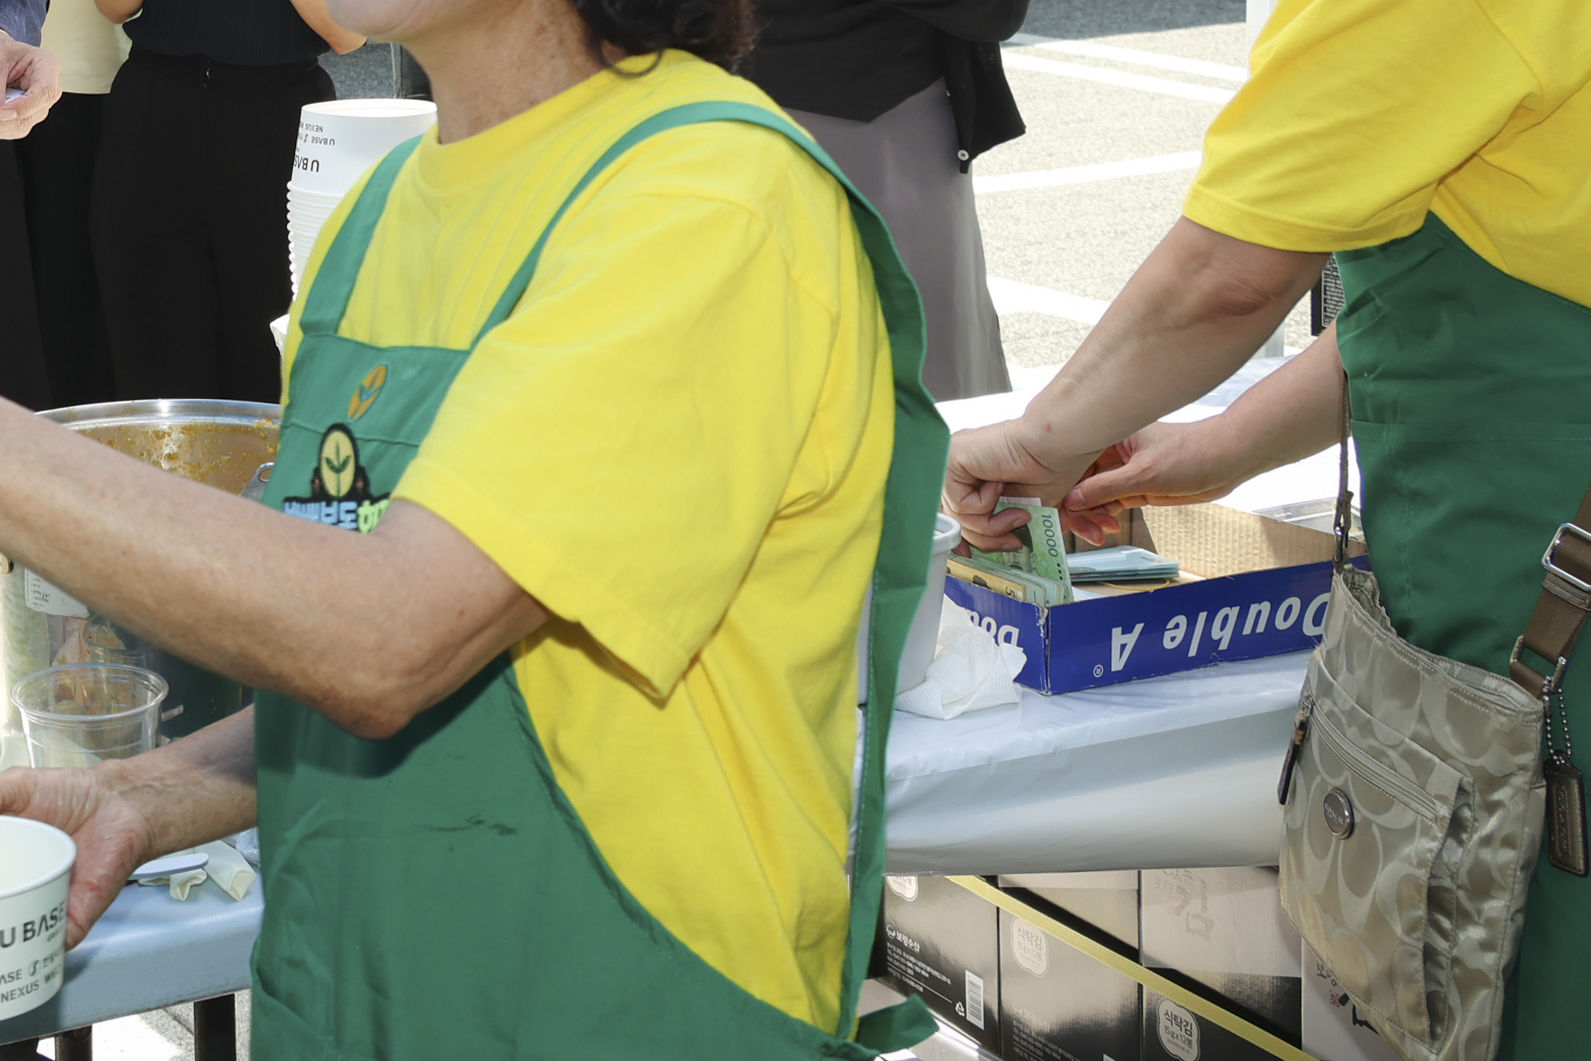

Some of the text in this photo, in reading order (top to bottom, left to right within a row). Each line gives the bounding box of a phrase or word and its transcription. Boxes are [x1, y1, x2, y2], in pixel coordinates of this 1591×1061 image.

[293, 155, 309, 171] BAS
[1041, 513, 1059, 558] 10000
[1110, 592, 1332, 672] Double A
[896, 930, 921, 954] 보령수산
[1017, 925, 1043, 952] 식탁김
[0, 979, 40, 1003] NEXUS
[1164, 1009, 1193, 1038] 식탁김
